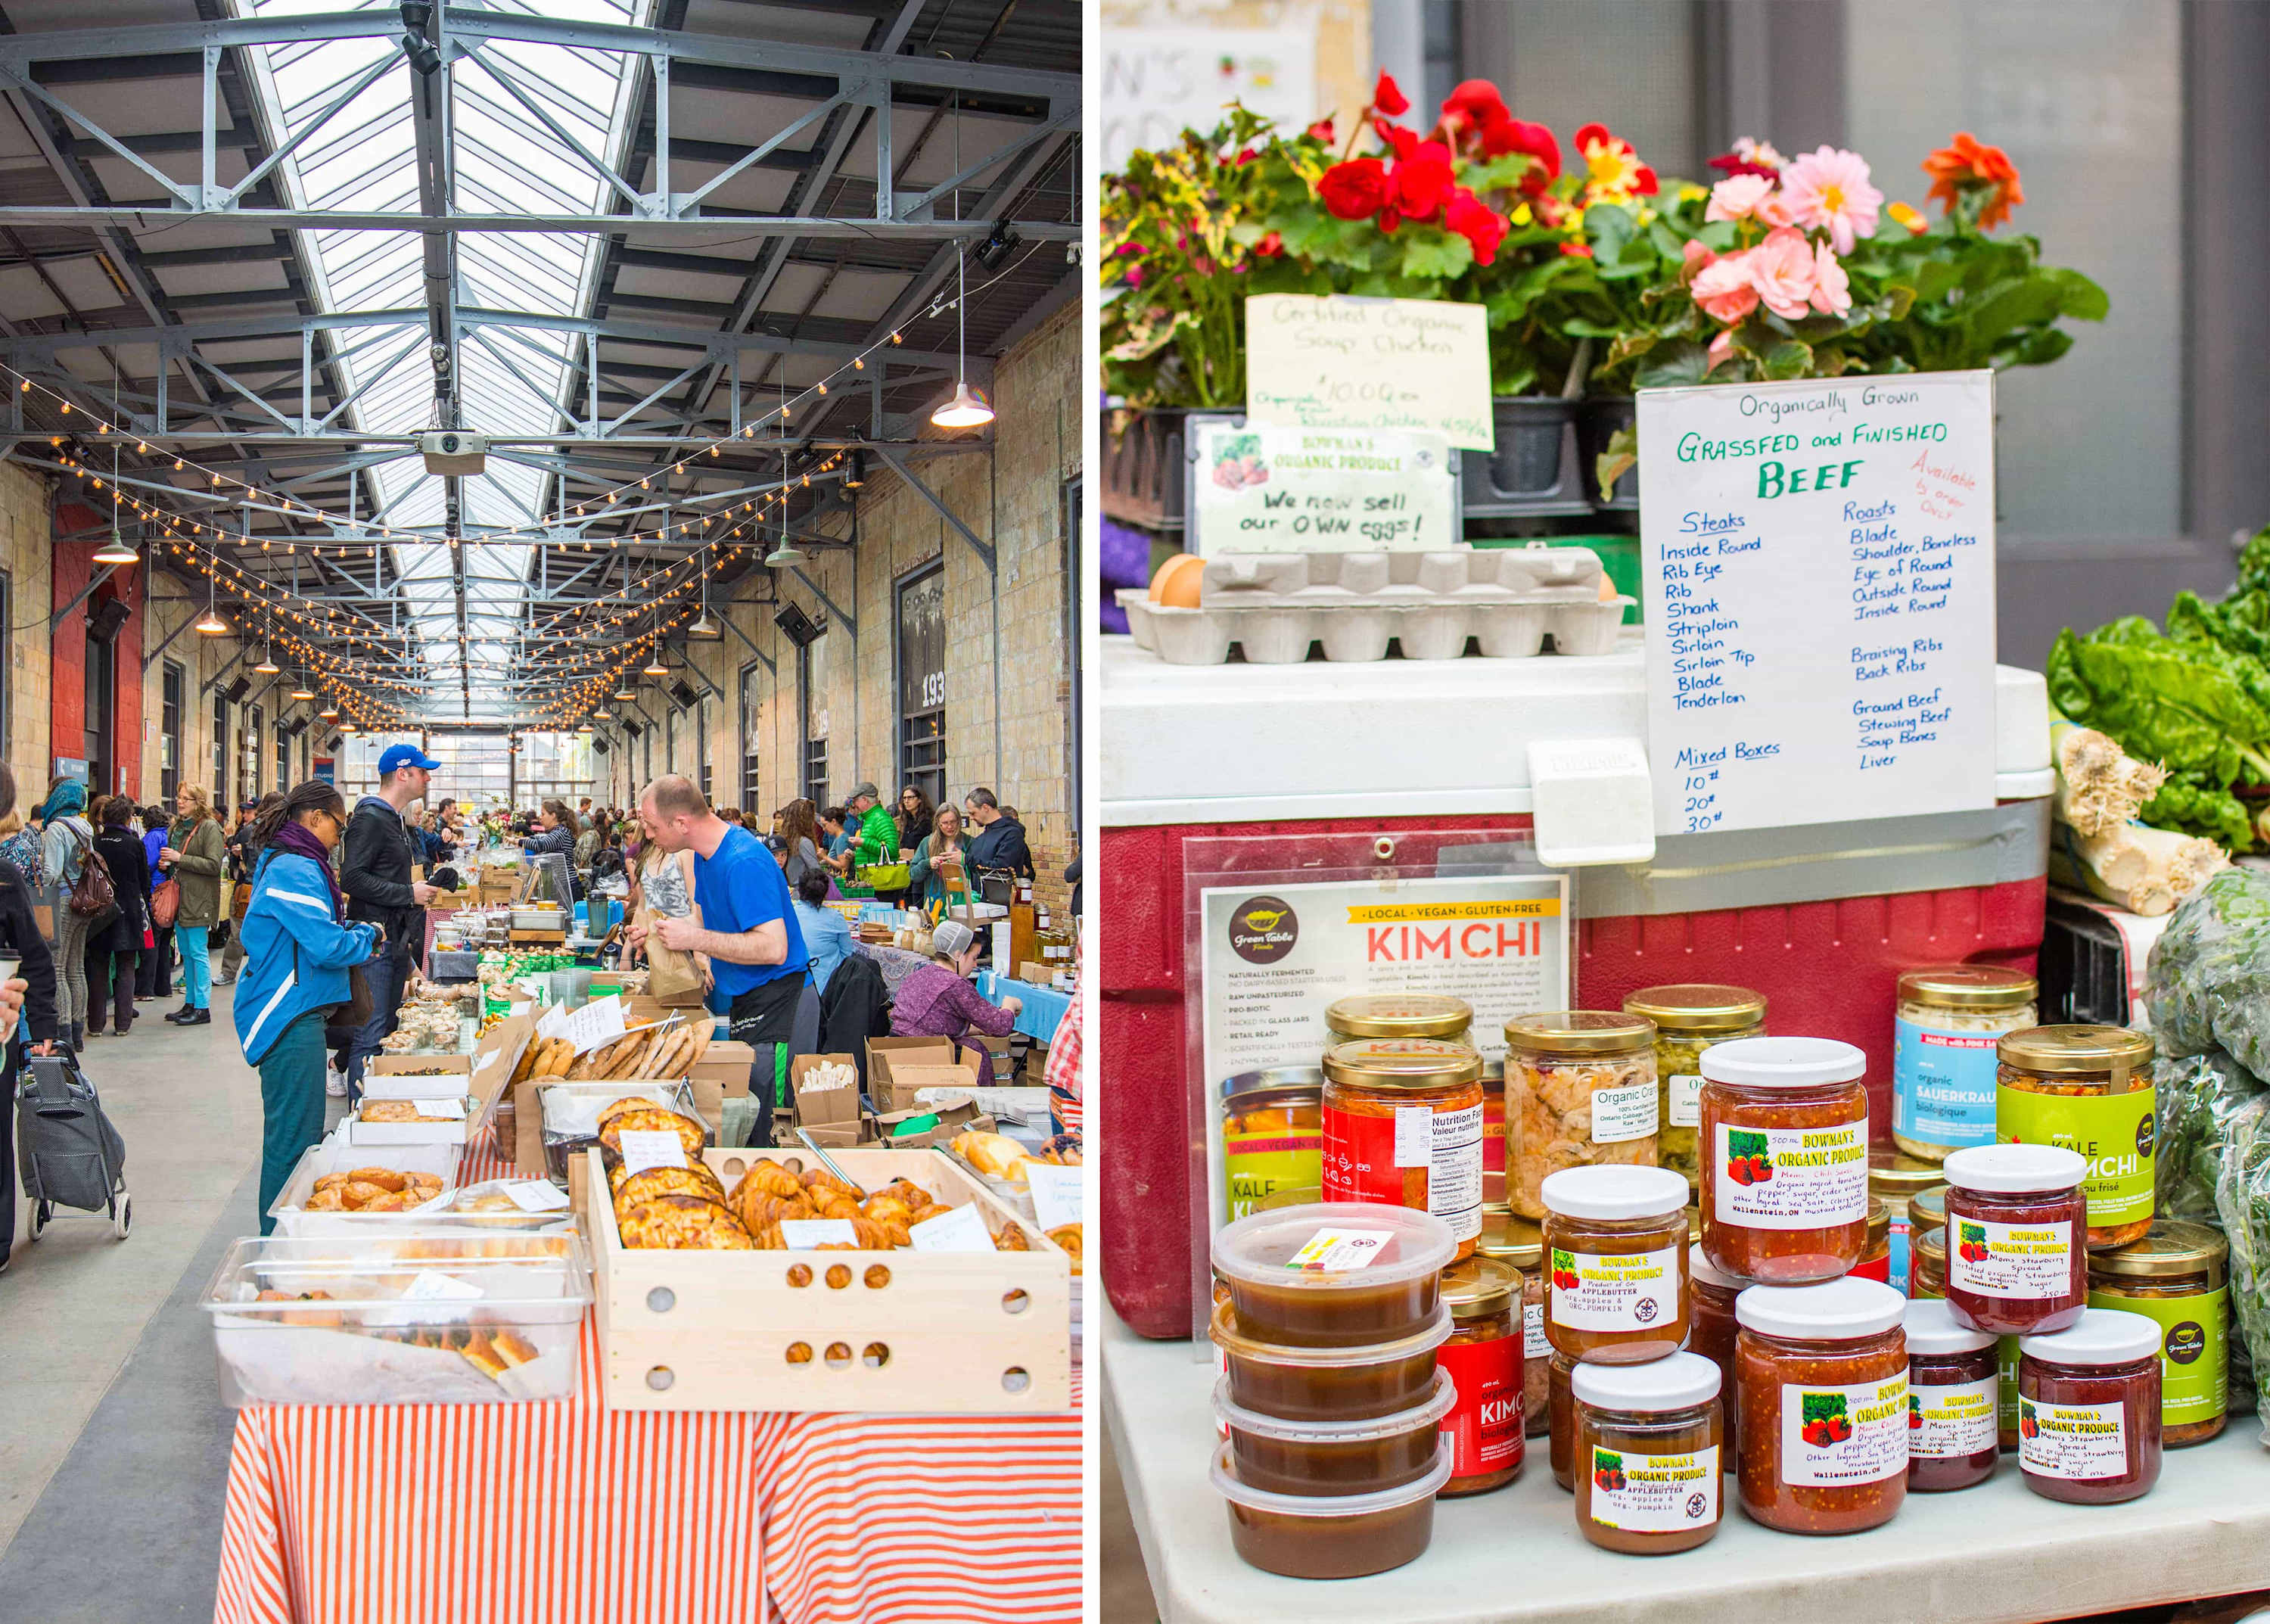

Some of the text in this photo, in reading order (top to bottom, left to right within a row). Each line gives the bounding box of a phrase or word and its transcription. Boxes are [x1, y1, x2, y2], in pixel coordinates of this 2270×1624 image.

[1740, 386, 1920, 423] Organically Grown
[1677, 423, 1948, 462] GRASSFED and FINISHED
[1911, 448, 1976, 491] Available
[1758, 460, 1865, 499] BEEF
[1264, 491, 1407, 511] We now sell
[1843, 500, 1896, 522] Roasts
[1240, 514, 1423, 542] our OWN eggs!
[1679, 512, 1746, 533] Steaks
[1850, 524, 1898, 545] Blade
[1922, 533, 1976, 552] Boneless
[1661, 537, 1762, 561] Inside Round
[1663, 562, 1724, 583] Rib Eye
[1854, 553, 1952, 586] Eye of Round
[1665, 583, 1692, 599] Rib
[1852, 577, 1951, 603] Outside Round
[1667, 597, 1720, 618] Shank
[1855, 595, 1947, 621] Inside Round
[1666, 618, 1739, 638] Striploin
[1671, 639, 1724, 655] Sirloin
[1852, 638, 1943, 663] Braising Ribs
[1672, 649, 1755, 673] Sirloin Tip
[1855, 659, 1926, 681] Back Ribs
[1678, 673, 1724, 692] Blade
[1853, 687, 1942, 715] Ground Beef
[1858, 707, 1952, 733] Stewing Beef
[1856, 731, 1937, 750] Soup Bones
[1675, 742, 1781, 769] Mixed Boxes
[1860, 754, 1898, 770] Liver
[1368, 904, 1542, 919] LOCAL VEGAN GLUTEN-FREE
[1234, 932, 1294, 947] Green Table
[1367, 921, 1541, 963] KIMCHI
[1228, 968, 1315, 979] NATURALLY FERMENTED
[1246, 990, 1304, 1000] UNPASTEURIZED
[1267, 1016, 1291, 1025] GLASS
[1917, 1074, 1952, 1085] organic
[1597, 1090, 1640, 1106] Organic
[1917, 1085, 1997, 1103] SAUERKRAU
[1915, 1100, 1967, 1118] biologique
[1432, 1113, 1470, 1127] Nutrition
[1432, 1126, 1457, 1136] Valeur
[1802, 1129, 1855, 1148] BOWMAN'S
[1268, 1140, 1306, 1151] VEGAN
[1776, 1143, 1865, 1167] ORGANIC PRODUCE
[1822, 1187, 1841, 1196] cider
[1733, 1205, 1799, 1216] Wallenstein,ON
[2009, 1230, 2057, 1243] BOWMAN'S
[1989, 1242, 2032, 1255] ORGANIC
[1599, 1255, 1650, 1268] BOWMAN'S
[1581, 1268, 1622, 1281] ORGANIC
[1856, 1400, 1898, 1423] ORGANIC
[2054, 1409, 2101, 1421] BOWMAN'S
[2040, 1418, 2119, 1434] ORGANIC PRODUCE
[1647, 1455, 1695, 1468] BOWMAN'S
[1806, 1453, 1830, 1461] Other
[1628, 1466, 1707, 1482] ORGANIC PRODUCE
[1814, 1467, 1880, 1478] Wallenstein,ON
[1627, 1486, 1684, 1495] APPLEBUTTER
[1637, 1503, 1673, 1511] pumpkin
